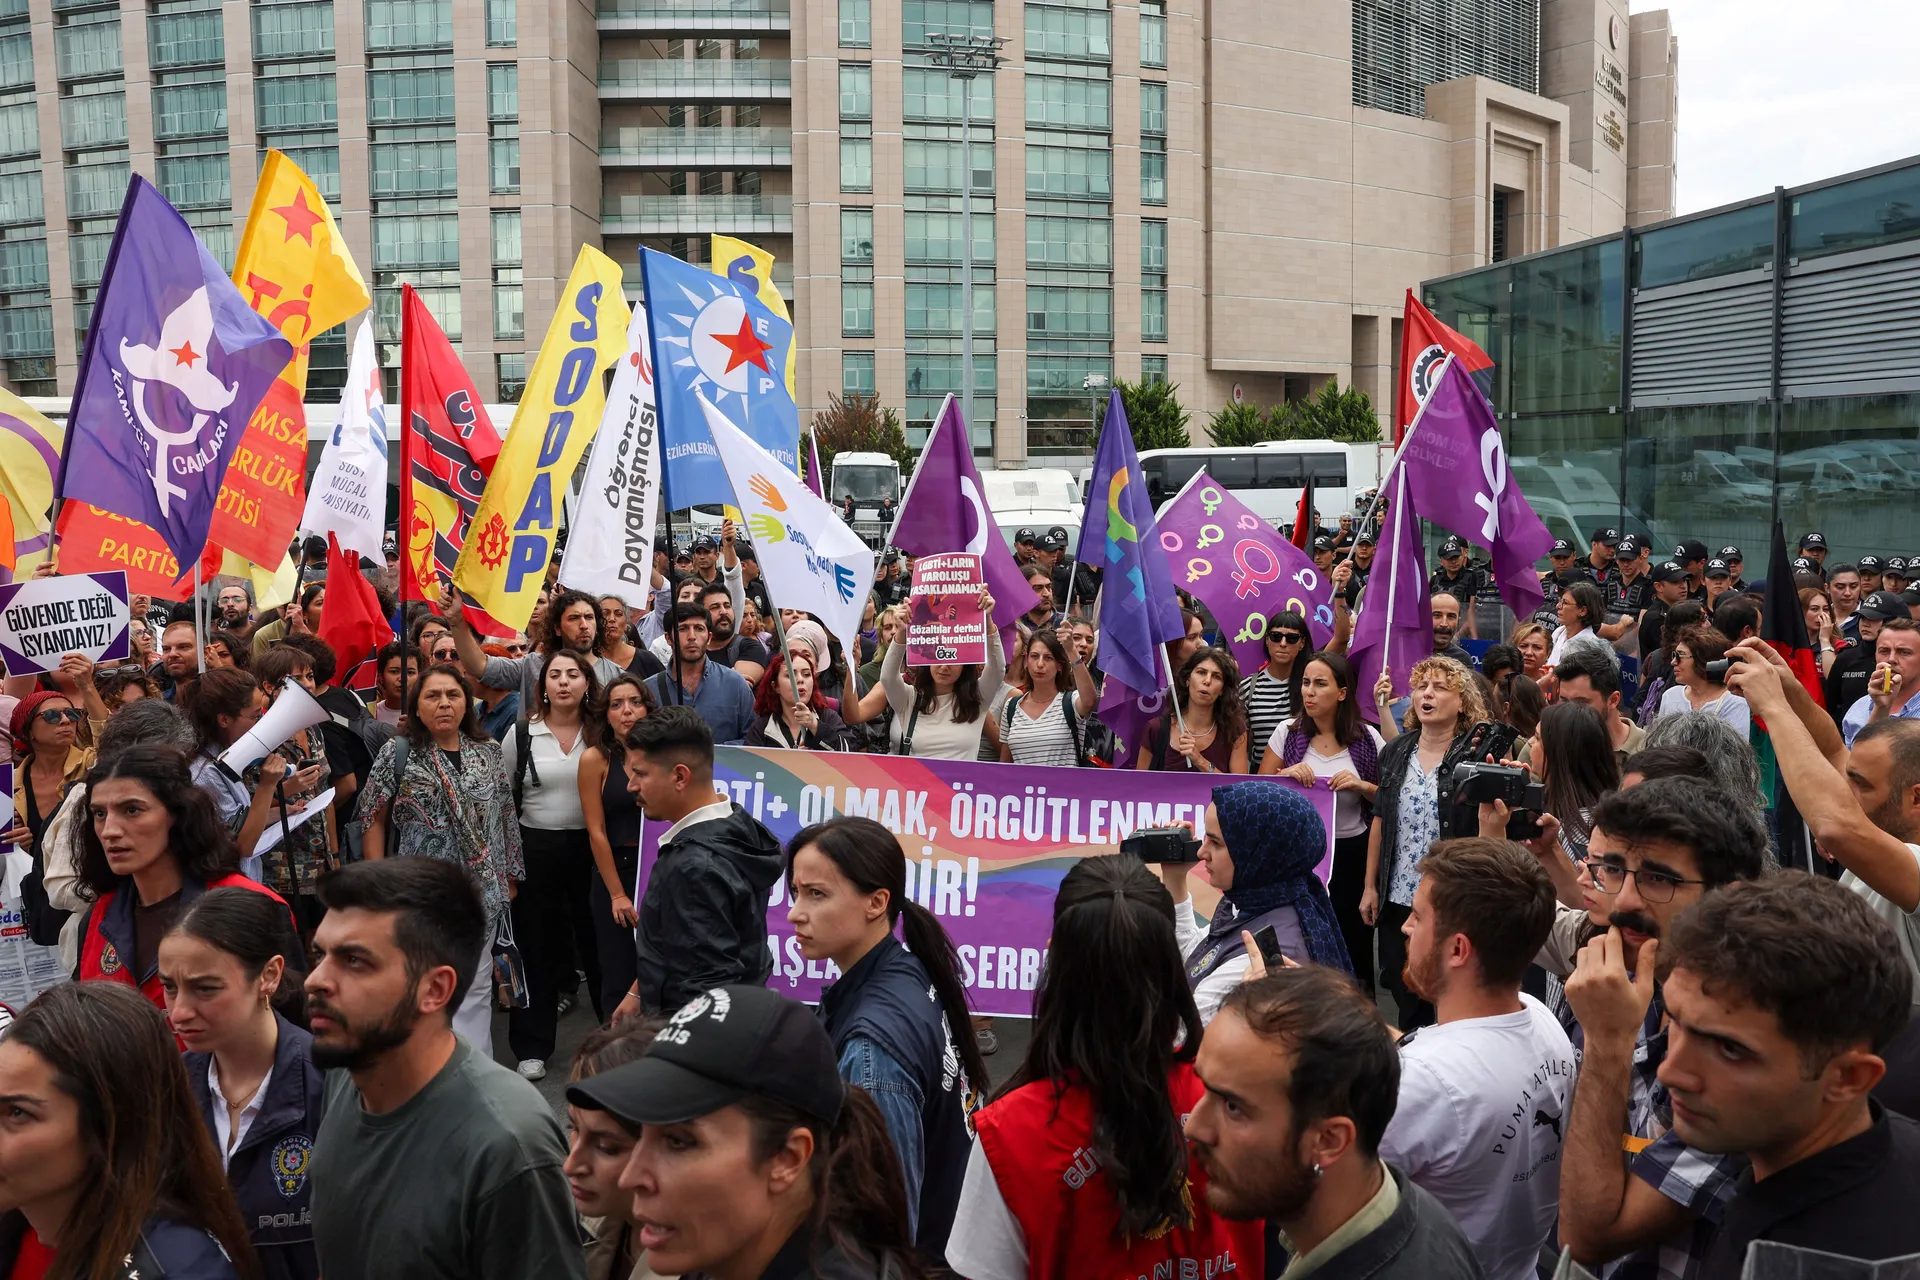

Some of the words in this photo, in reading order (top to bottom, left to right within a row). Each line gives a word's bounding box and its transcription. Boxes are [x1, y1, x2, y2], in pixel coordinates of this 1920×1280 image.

[504, 281, 603, 593] SODAP
[604, 393, 640, 509] Öğrenci
[618, 402, 656, 585] Dayanışması
[98, 537, 180, 578] PARTİS
[918, 557, 975, 572] LGBTİ+LARIN
[921, 570, 970, 583] VAROLUŞU
[910, 583, 982, 597] YASAKLANAMAZ
[5, 601, 78, 632] GÜVENDE
[78, 594, 117, 621] DEĞİL
[909, 624, 952, 635] Gözaltılar
[954, 623, 982, 633] derhal
[906, 635, 940, 646] serbest
[941, 633, 985, 645] bırakılsın!
[1492, 1090, 1531, 1155] PUMA
